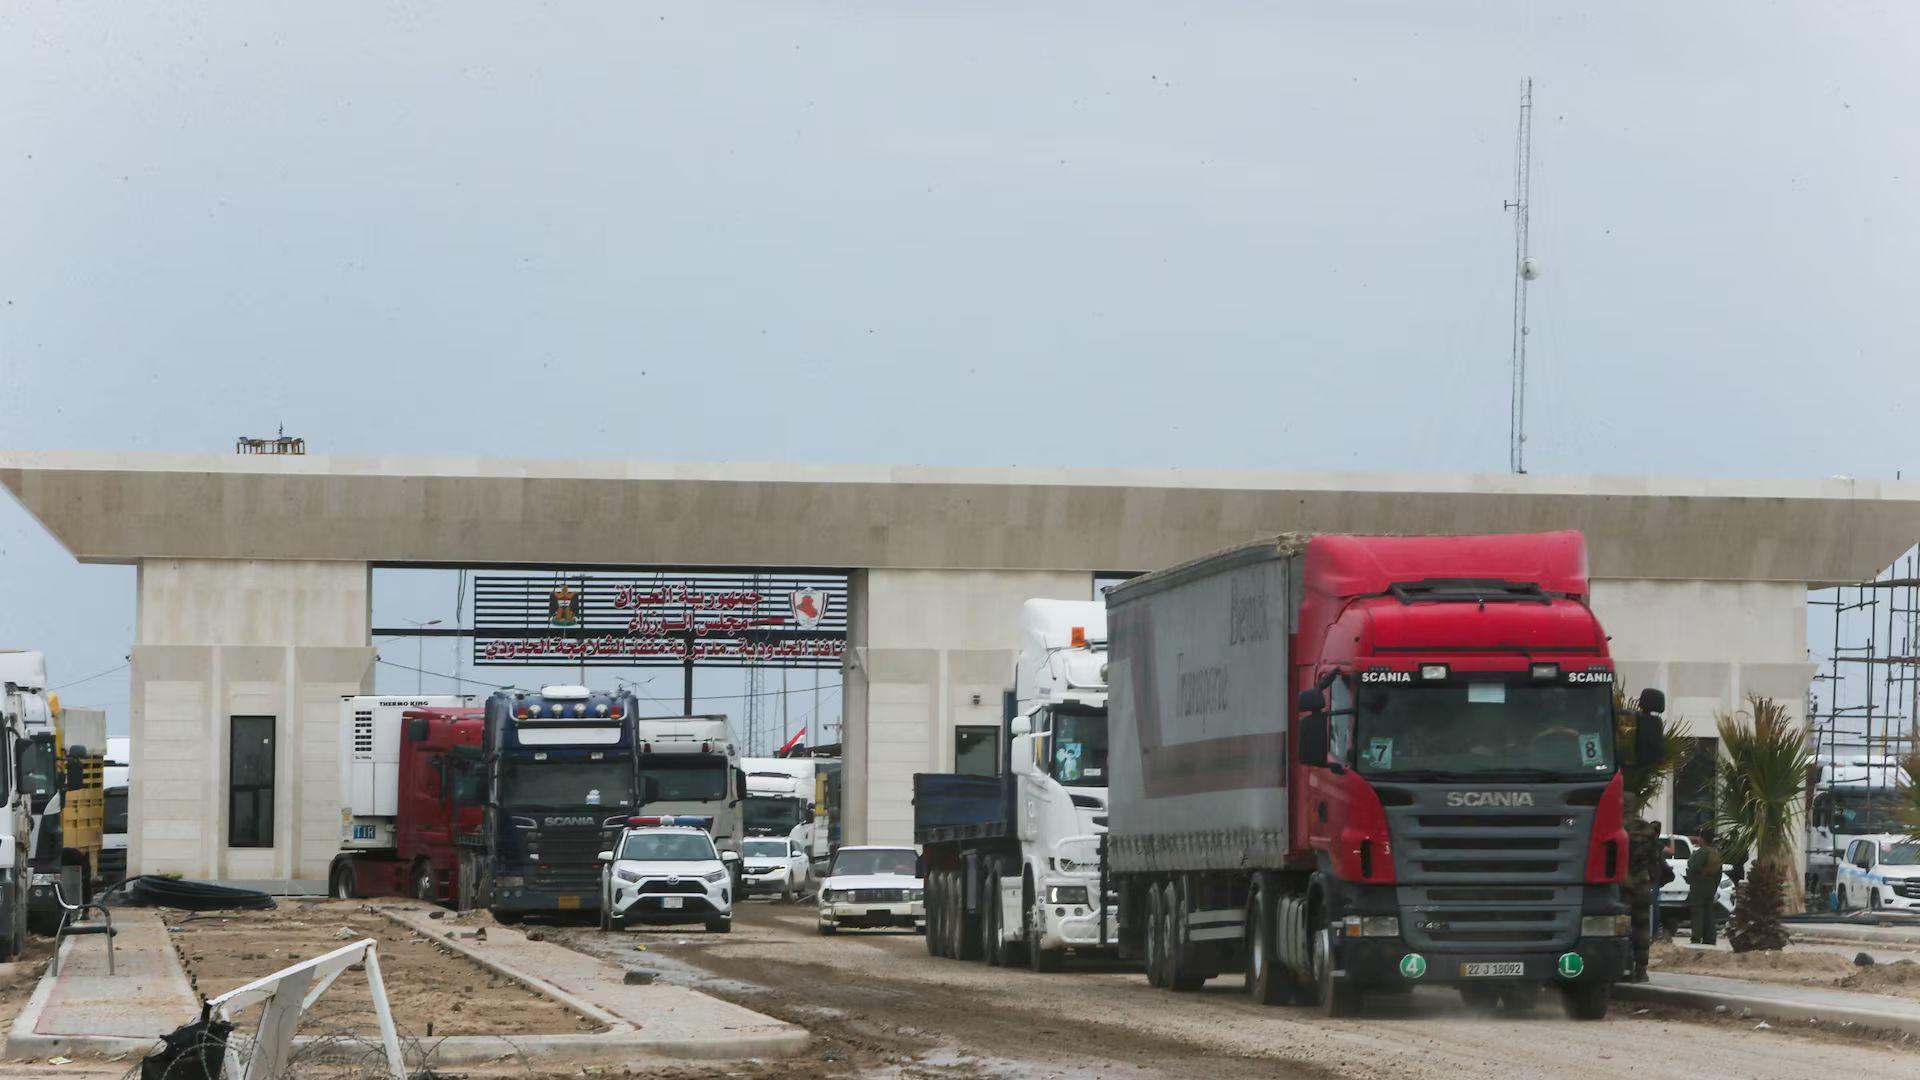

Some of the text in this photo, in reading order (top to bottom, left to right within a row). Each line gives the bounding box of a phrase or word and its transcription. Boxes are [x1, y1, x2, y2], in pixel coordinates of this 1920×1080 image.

[614, 584, 763, 613] جمهورية العراق
[628, 611, 750, 636] مجلس الوزراء
[1362, 672, 1411, 682] SCANIA
[1568, 672, 1613, 682] SCANIA
[1375, 744, 1387, 762] 7
[1585, 741, 1596, 758] 8
[1446, 791, 1534, 806] SCANIA
[544, 816, 595, 826] SCANIA
[354, 825, 375, 838] TIR
[1406, 960, 1418, 974] 4
[1564, 959, 1577, 973] L
